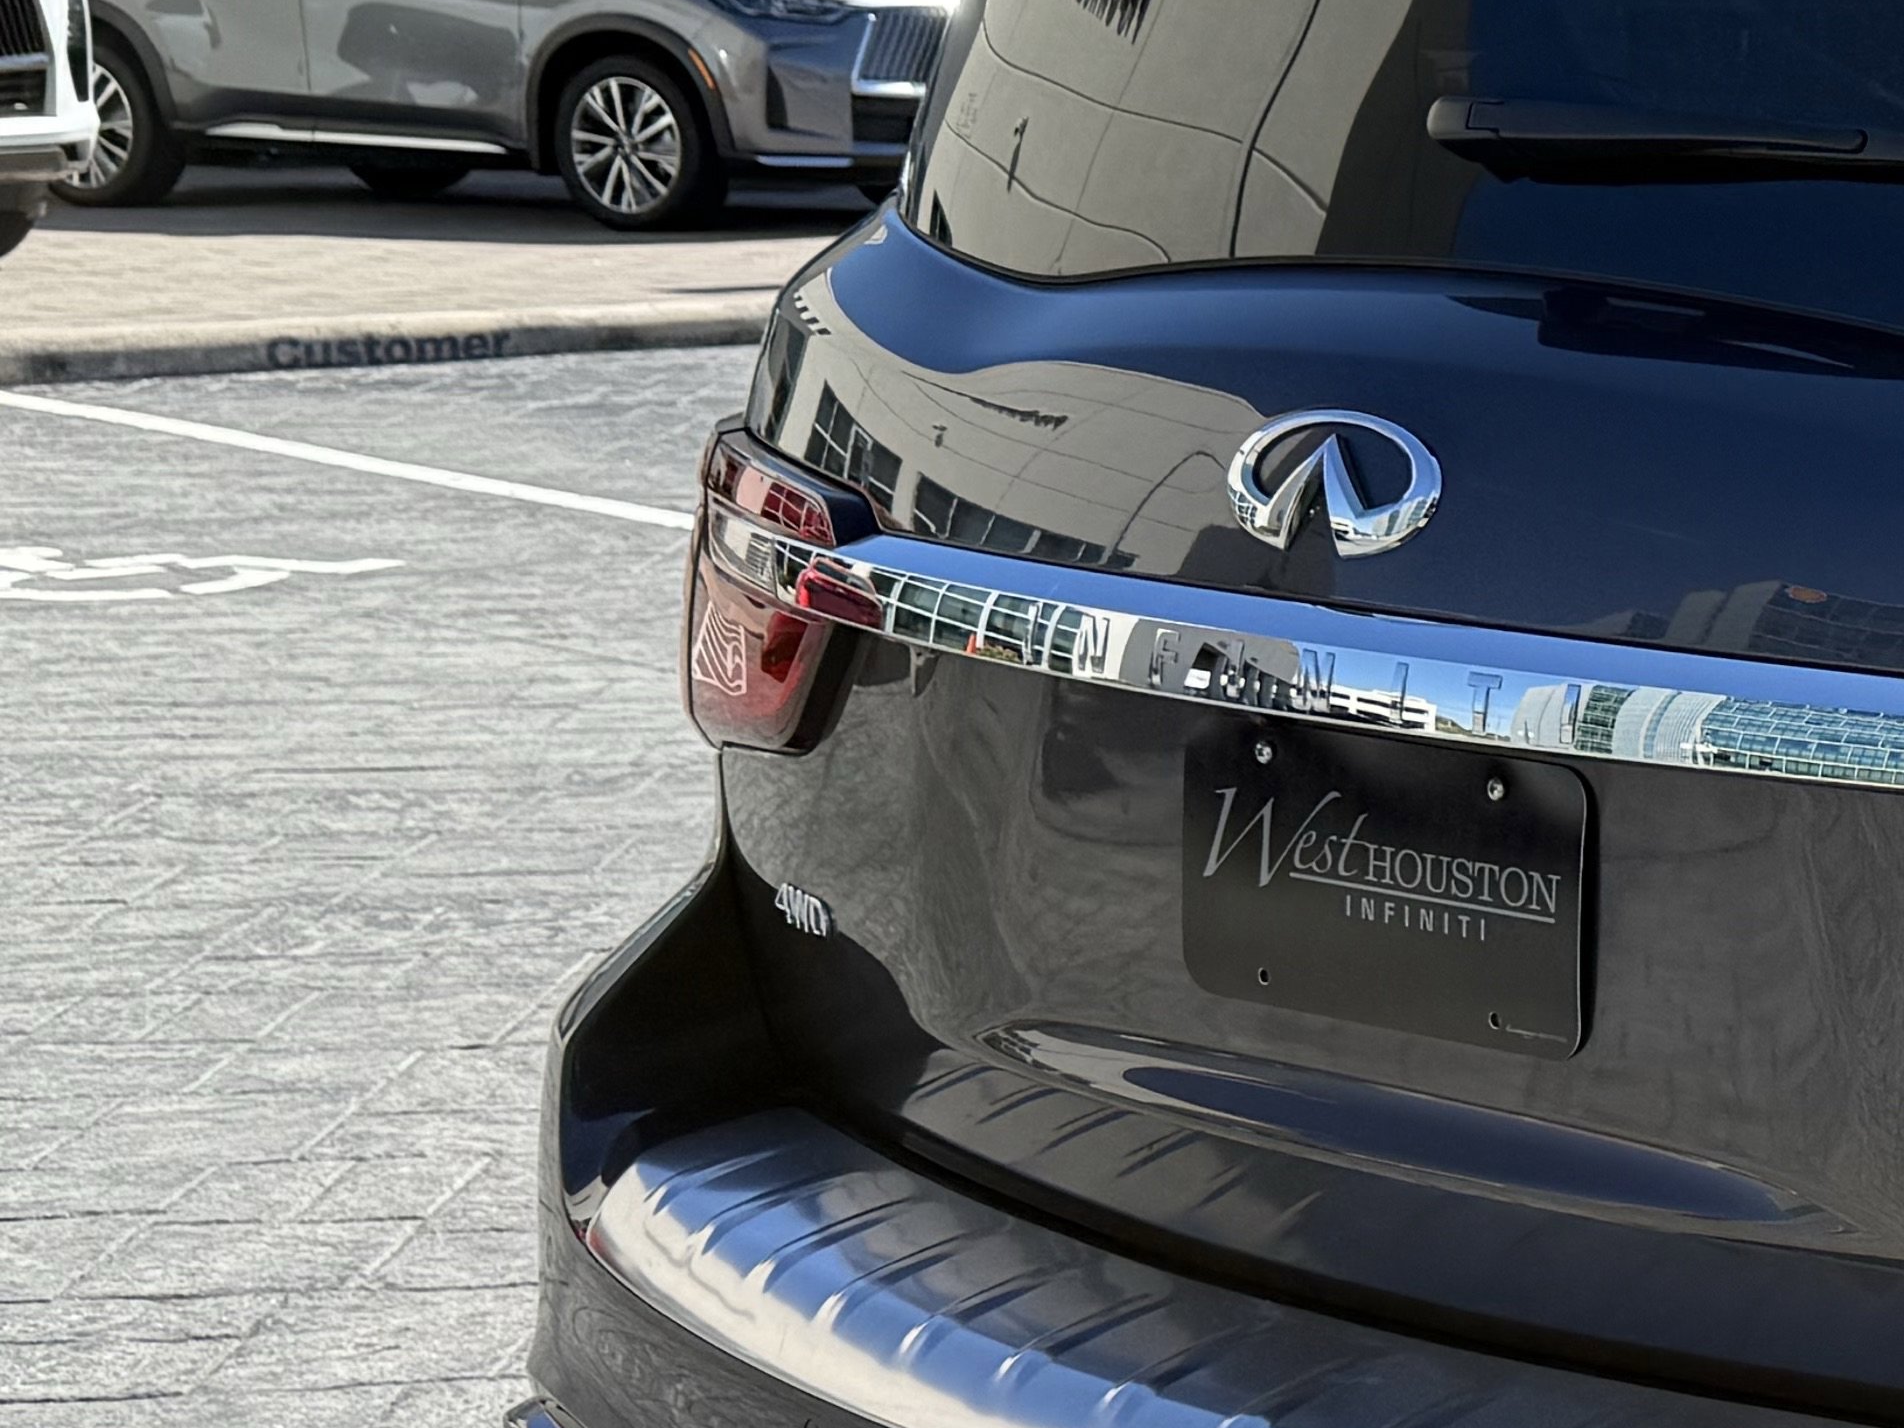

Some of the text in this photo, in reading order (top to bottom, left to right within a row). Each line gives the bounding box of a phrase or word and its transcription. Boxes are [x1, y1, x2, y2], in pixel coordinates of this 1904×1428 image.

[266, 329, 511, 368] Customer
[1023, 601, 1582, 744] INFINITI
[774, 882, 828, 938] 4WD
[1345, 894, 1486, 941] INFINITI
